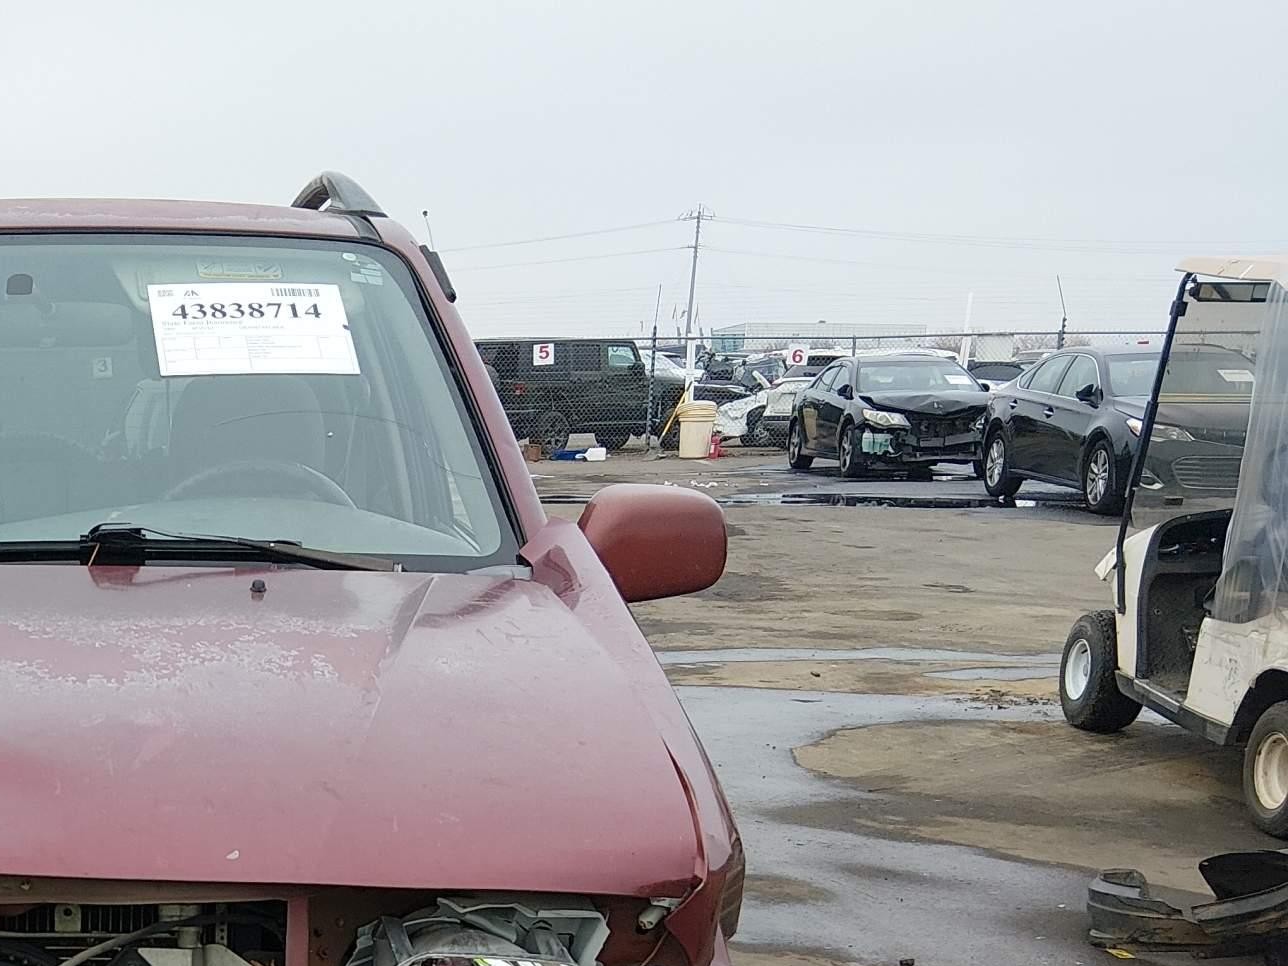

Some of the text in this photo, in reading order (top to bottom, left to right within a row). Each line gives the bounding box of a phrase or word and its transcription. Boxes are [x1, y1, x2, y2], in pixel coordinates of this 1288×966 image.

[171, 302, 323, 320] 43838714
[538, 345, 550, 360] 5
[792, 349, 804, 364] 6
